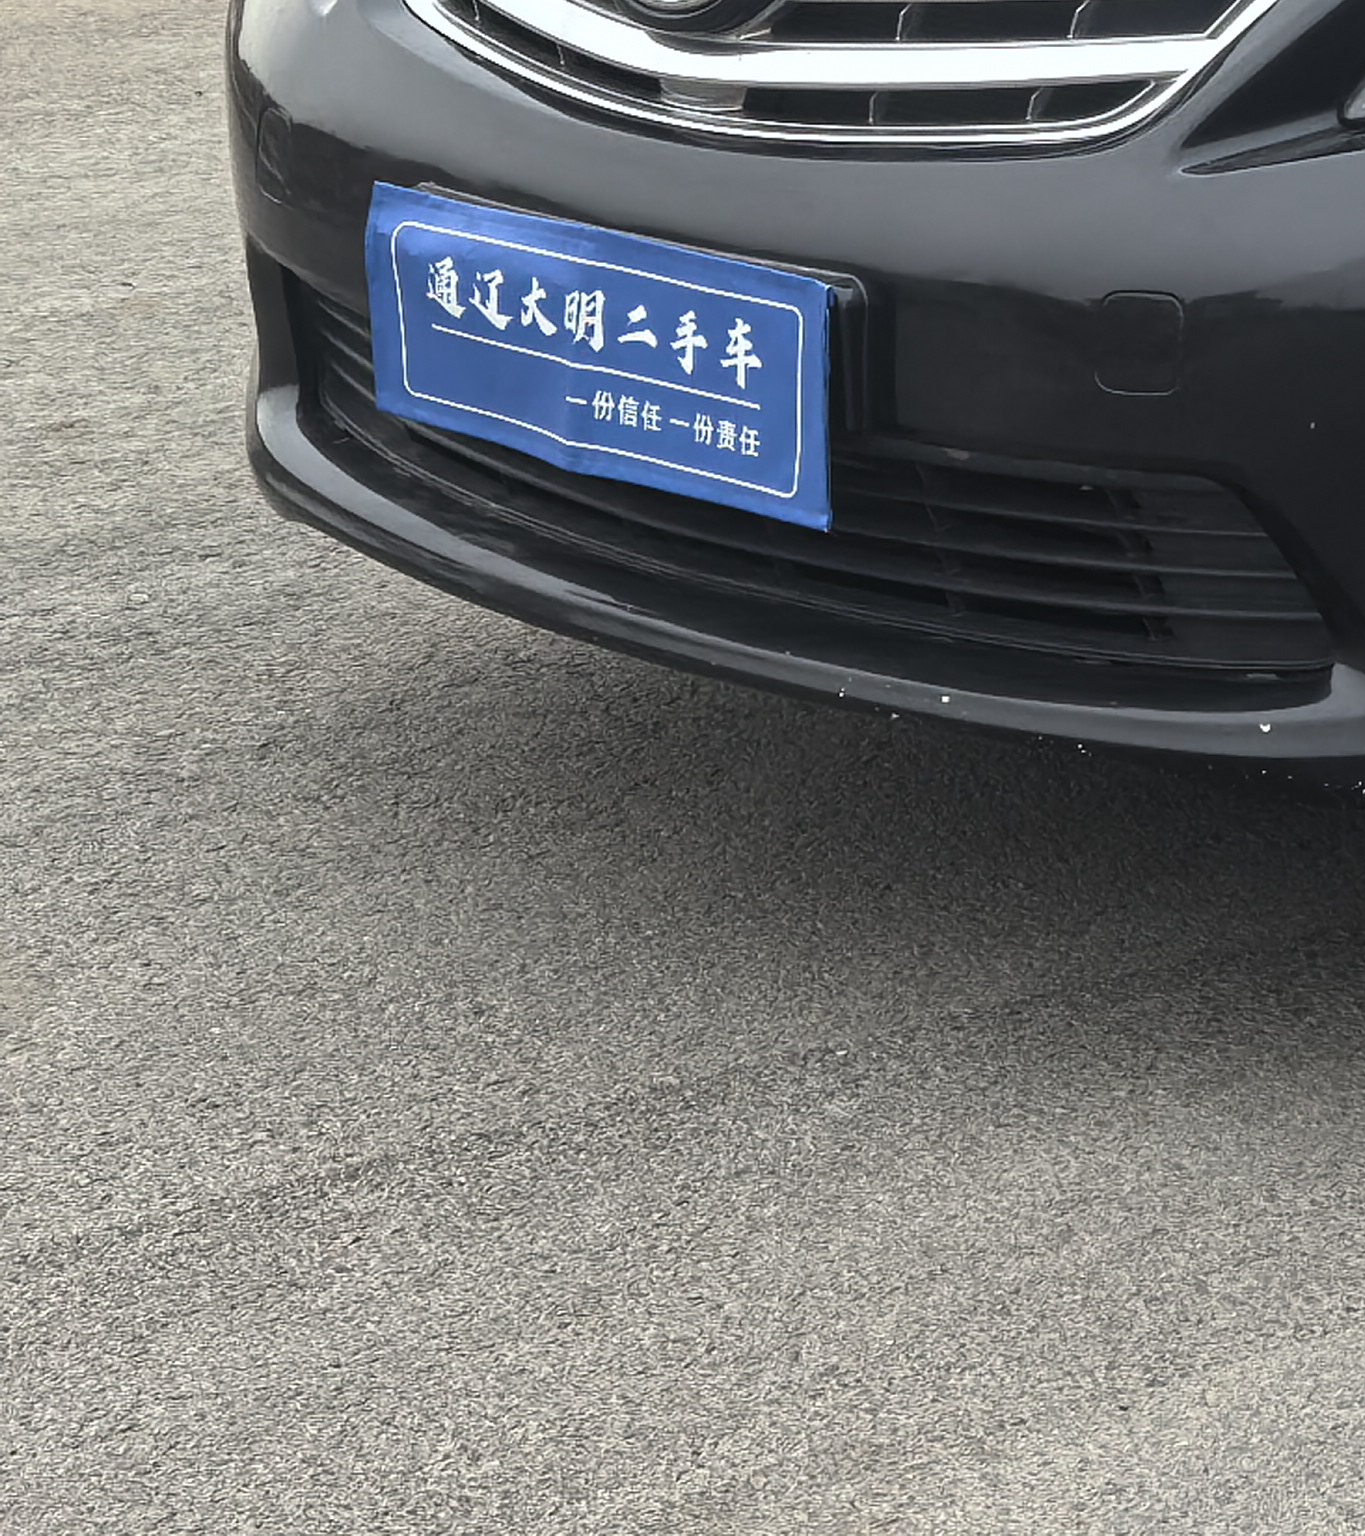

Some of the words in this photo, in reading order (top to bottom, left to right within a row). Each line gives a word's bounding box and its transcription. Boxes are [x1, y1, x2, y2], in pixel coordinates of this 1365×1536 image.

[426, 256, 762, 390] 通辽大明二手车
